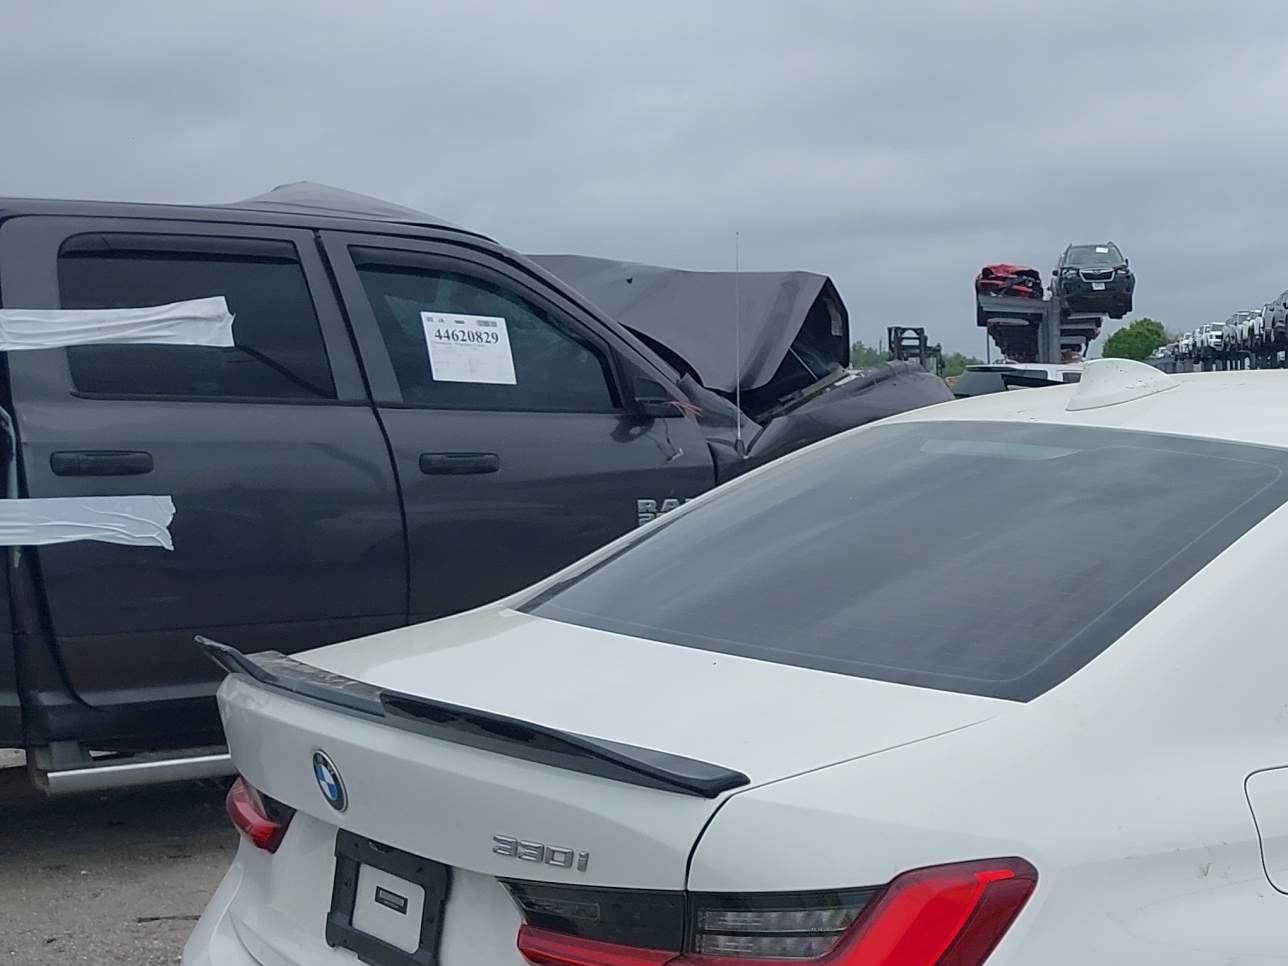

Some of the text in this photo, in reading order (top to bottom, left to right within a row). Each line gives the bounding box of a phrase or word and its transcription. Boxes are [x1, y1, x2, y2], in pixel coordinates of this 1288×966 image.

[434, 328, 499, 344] 44620829
[637, 498, 692, 512] RA
[491, 833, 590, 873] 330i
